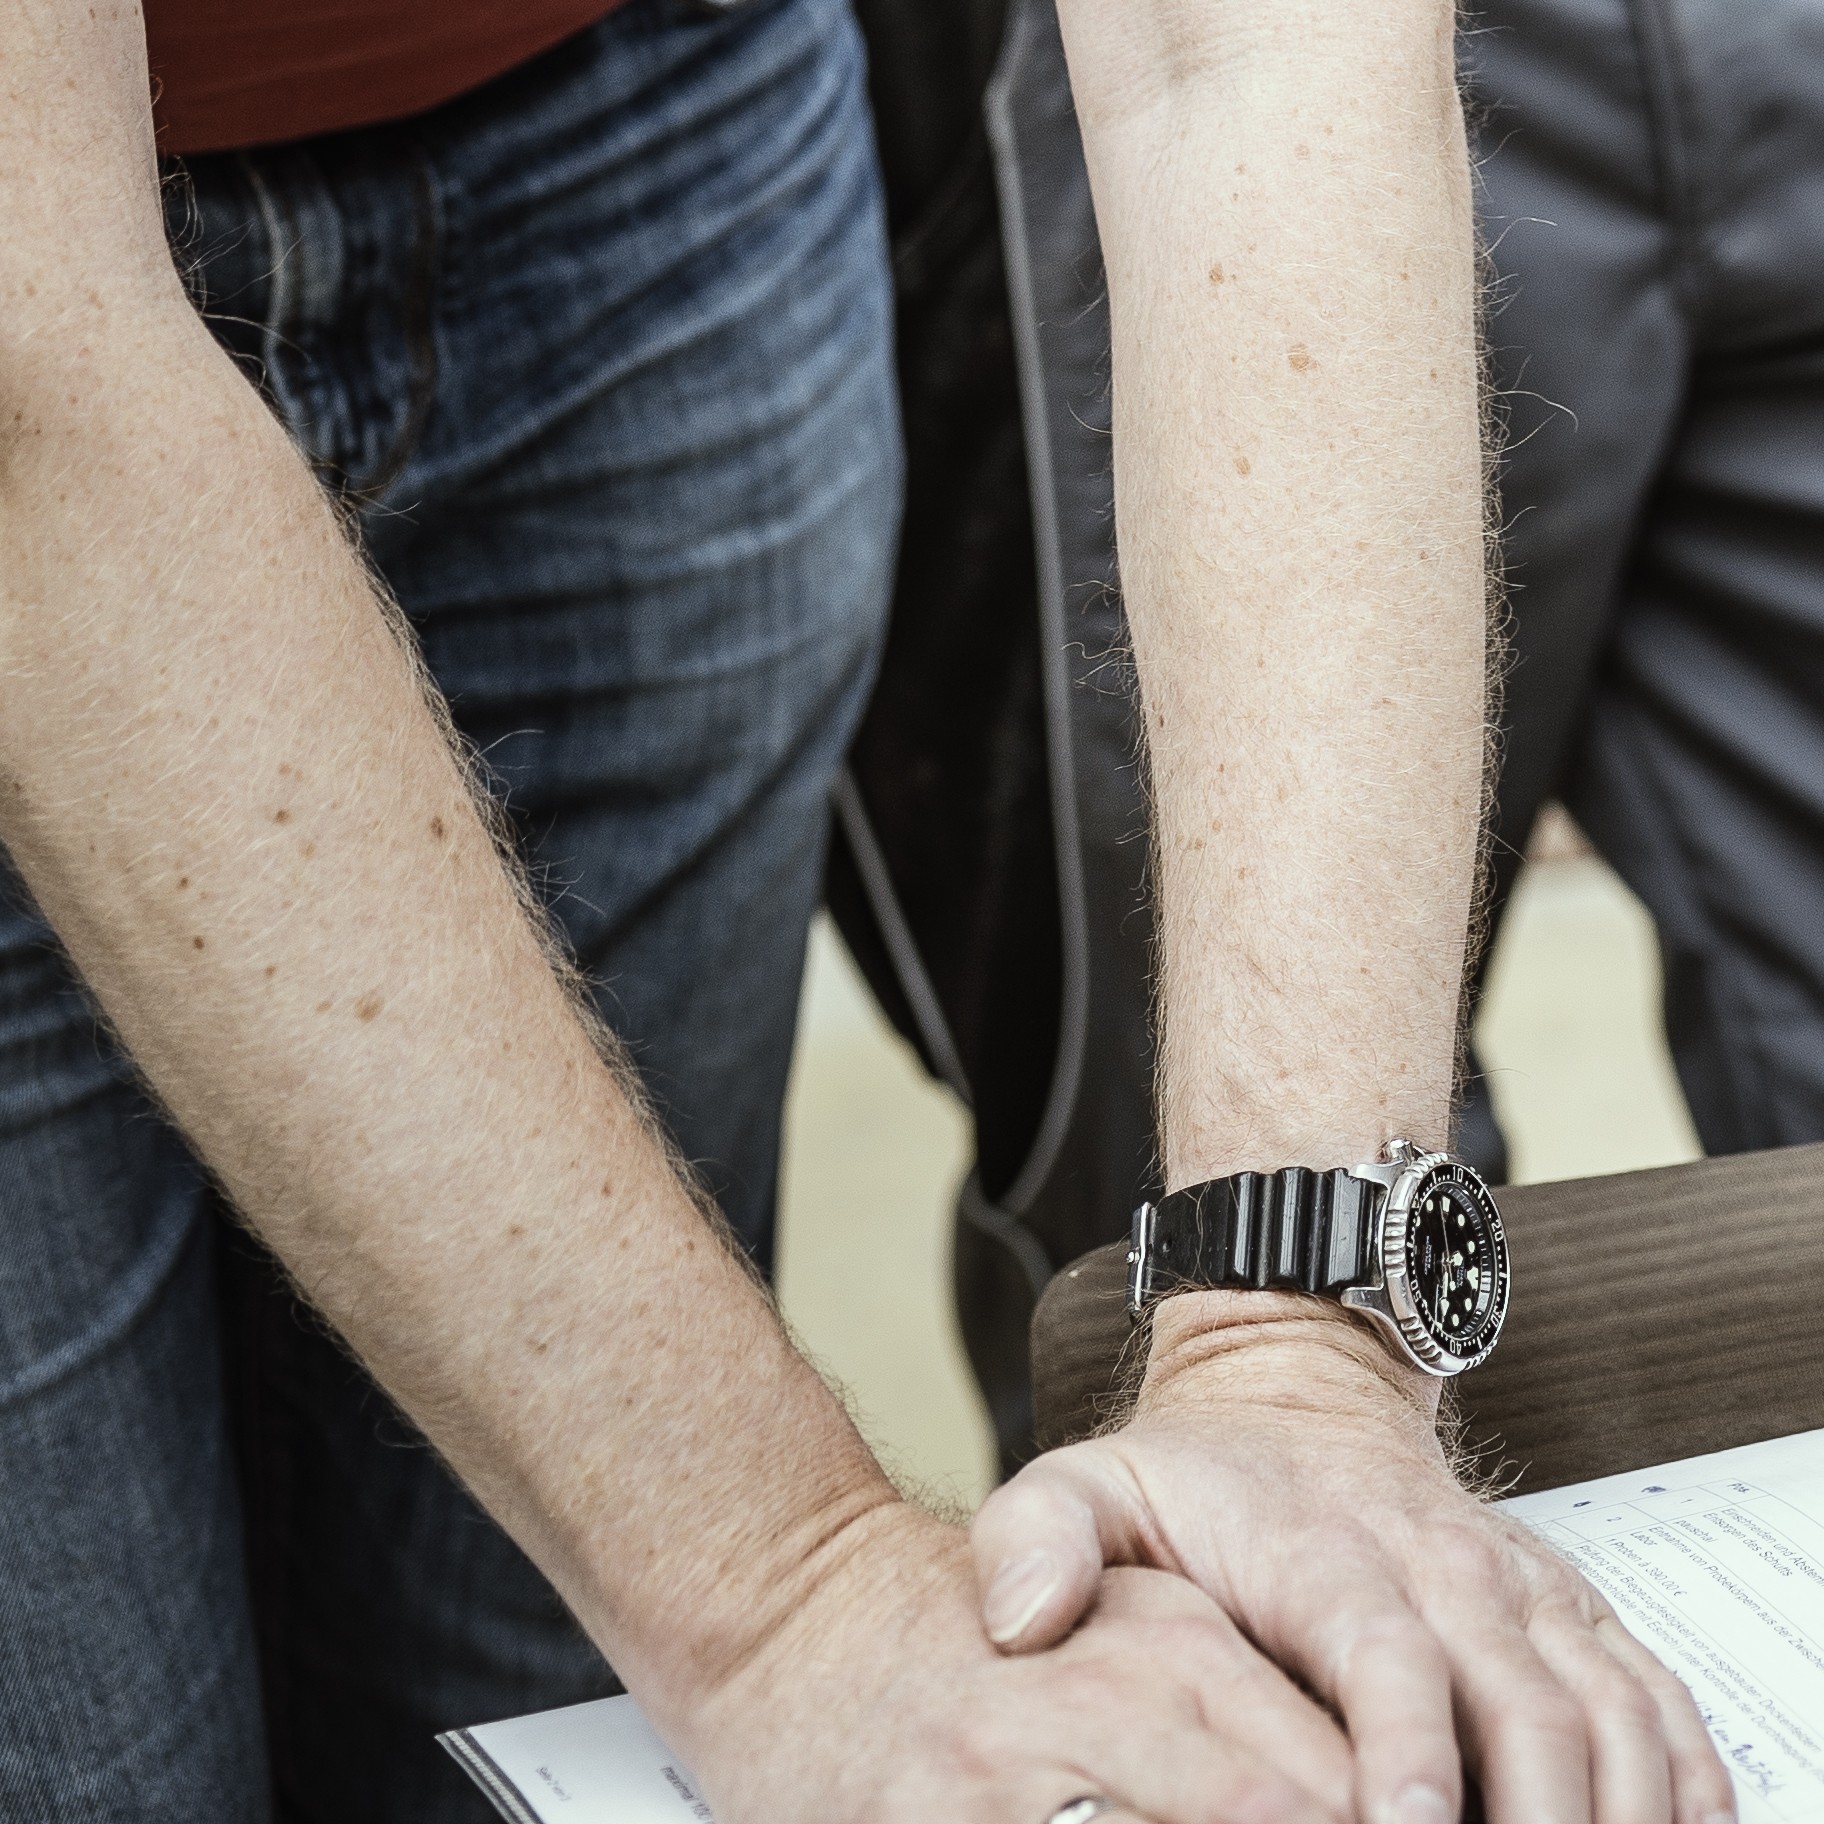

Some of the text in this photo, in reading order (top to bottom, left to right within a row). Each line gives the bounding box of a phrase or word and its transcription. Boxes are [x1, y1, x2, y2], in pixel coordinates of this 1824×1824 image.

[1452, 1165, 1463, 1183] 10
[1491, 1219, 1504, 1242] 20
[1410, 1279, 1422, 1303] 50
[1449, 1339, 1462, 1356] 40
[1631, 1530, 1657, 1547] Labor
[1673, 1519, 1716, 1543] pauschal
[1722, 1507, 1778, 1543] Einschneiden
[1774, 1542, 1794, 1556] und
[1611, 1541, 1641, 1561] Proben
[1703, 1511, 1794, 1577] Entsorgen des Schutts
[1649, 1525, 1692, 1554] Entnahme
[1688, 1553, 1705, 1566] von
[1757, 1611, 1775, 1625] aus
[1774, 1624, 1793, 1638] der
[1605, 1564, 1624, 1577] der
[1619, 1575, 1694, 1638] Biegezugfestigkeit
[1690, 1637, 1708, 1652] von
[1634, 1609, 1651, 1621] mit
[1678, 1649, 1700, 1668] unter
[1700, 1667, 1740, 1701] Kontrolle
[1736, 1701, 1756, 1716] der
